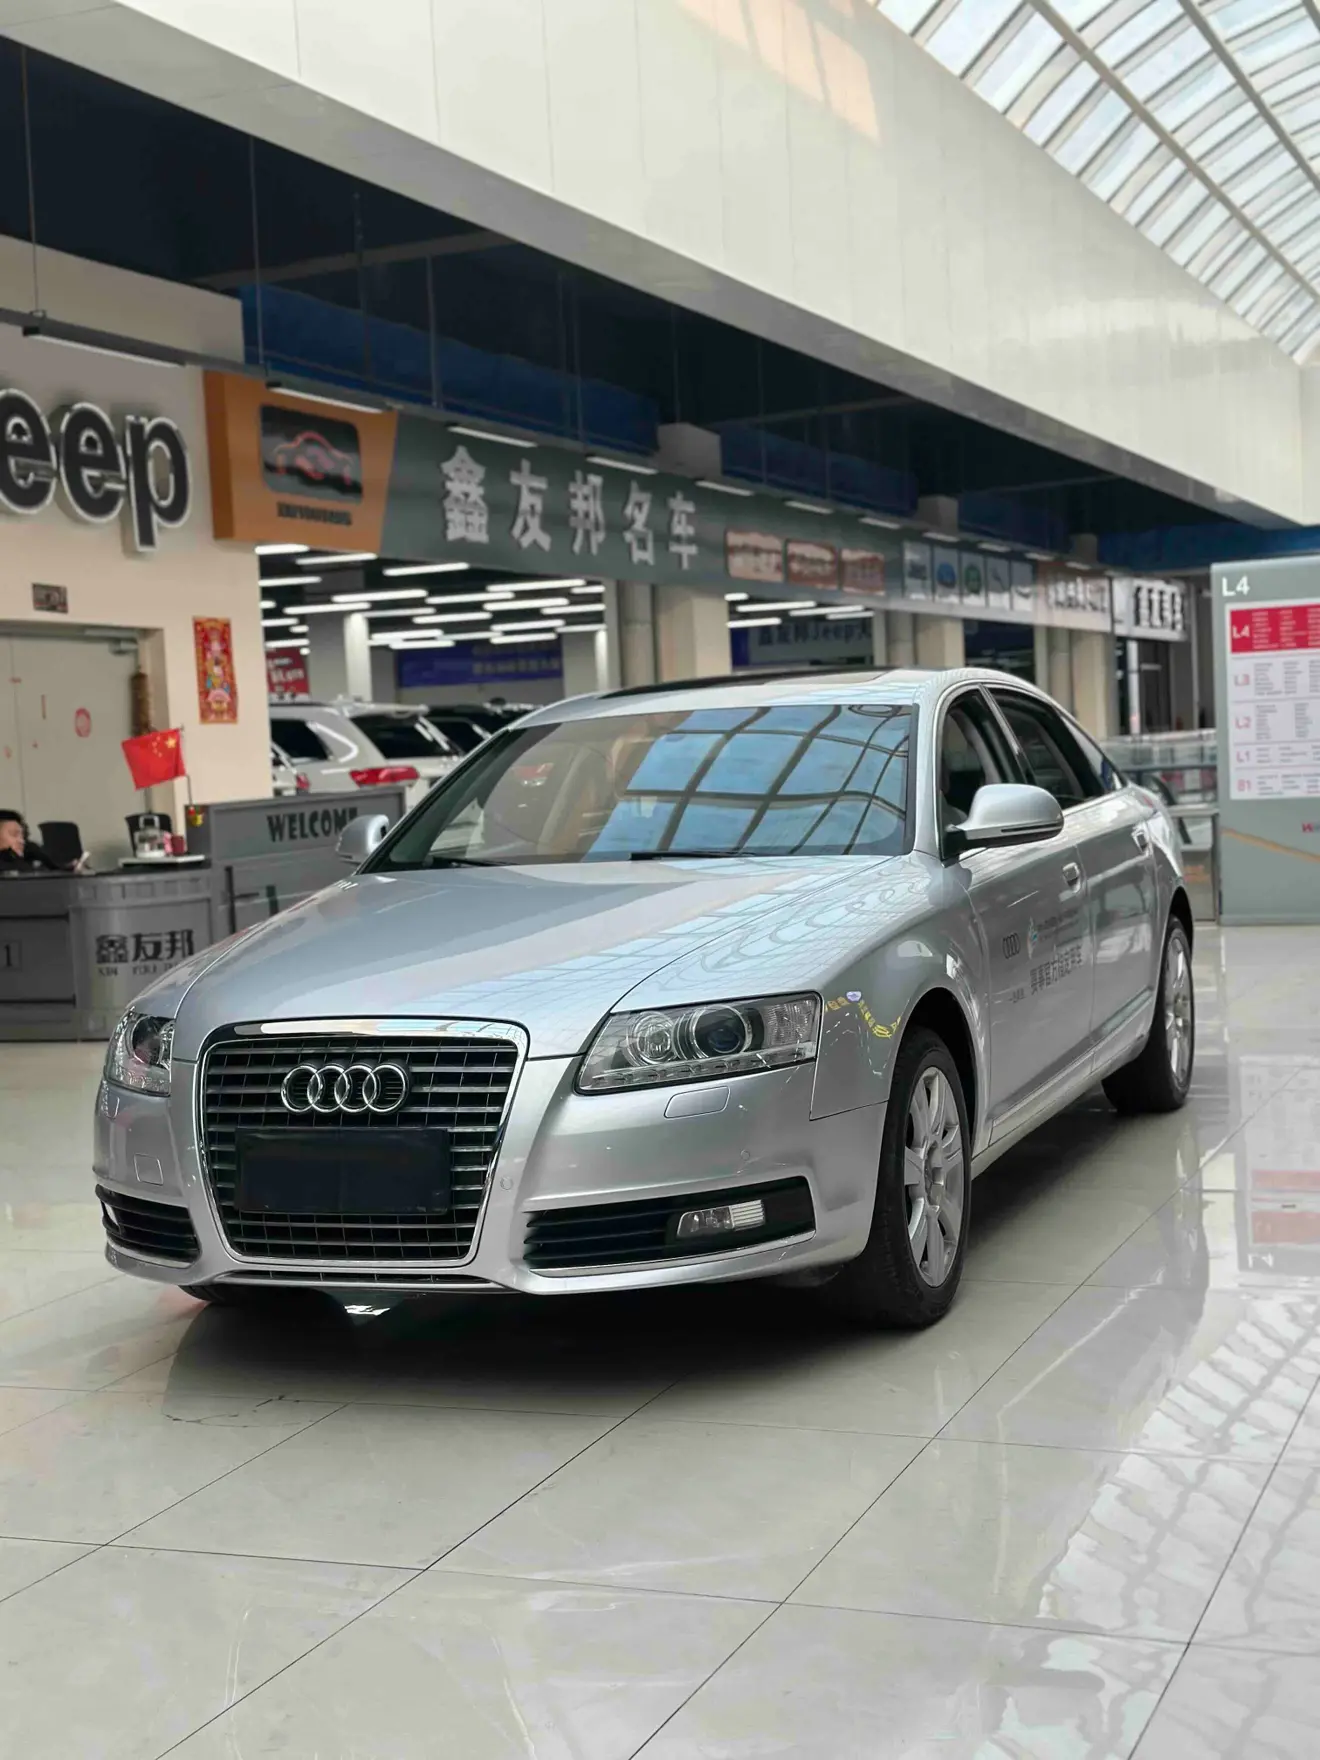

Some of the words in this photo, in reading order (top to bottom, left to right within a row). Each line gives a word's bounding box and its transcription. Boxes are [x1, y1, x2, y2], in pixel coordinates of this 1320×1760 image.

[440, 444, 698, 571] 鑫友邦名车
[1222, 576, 1250, 596] L4
[1232, 625, 1250, 639] L4
[96, 929, 194, 964] 鑫友邦
